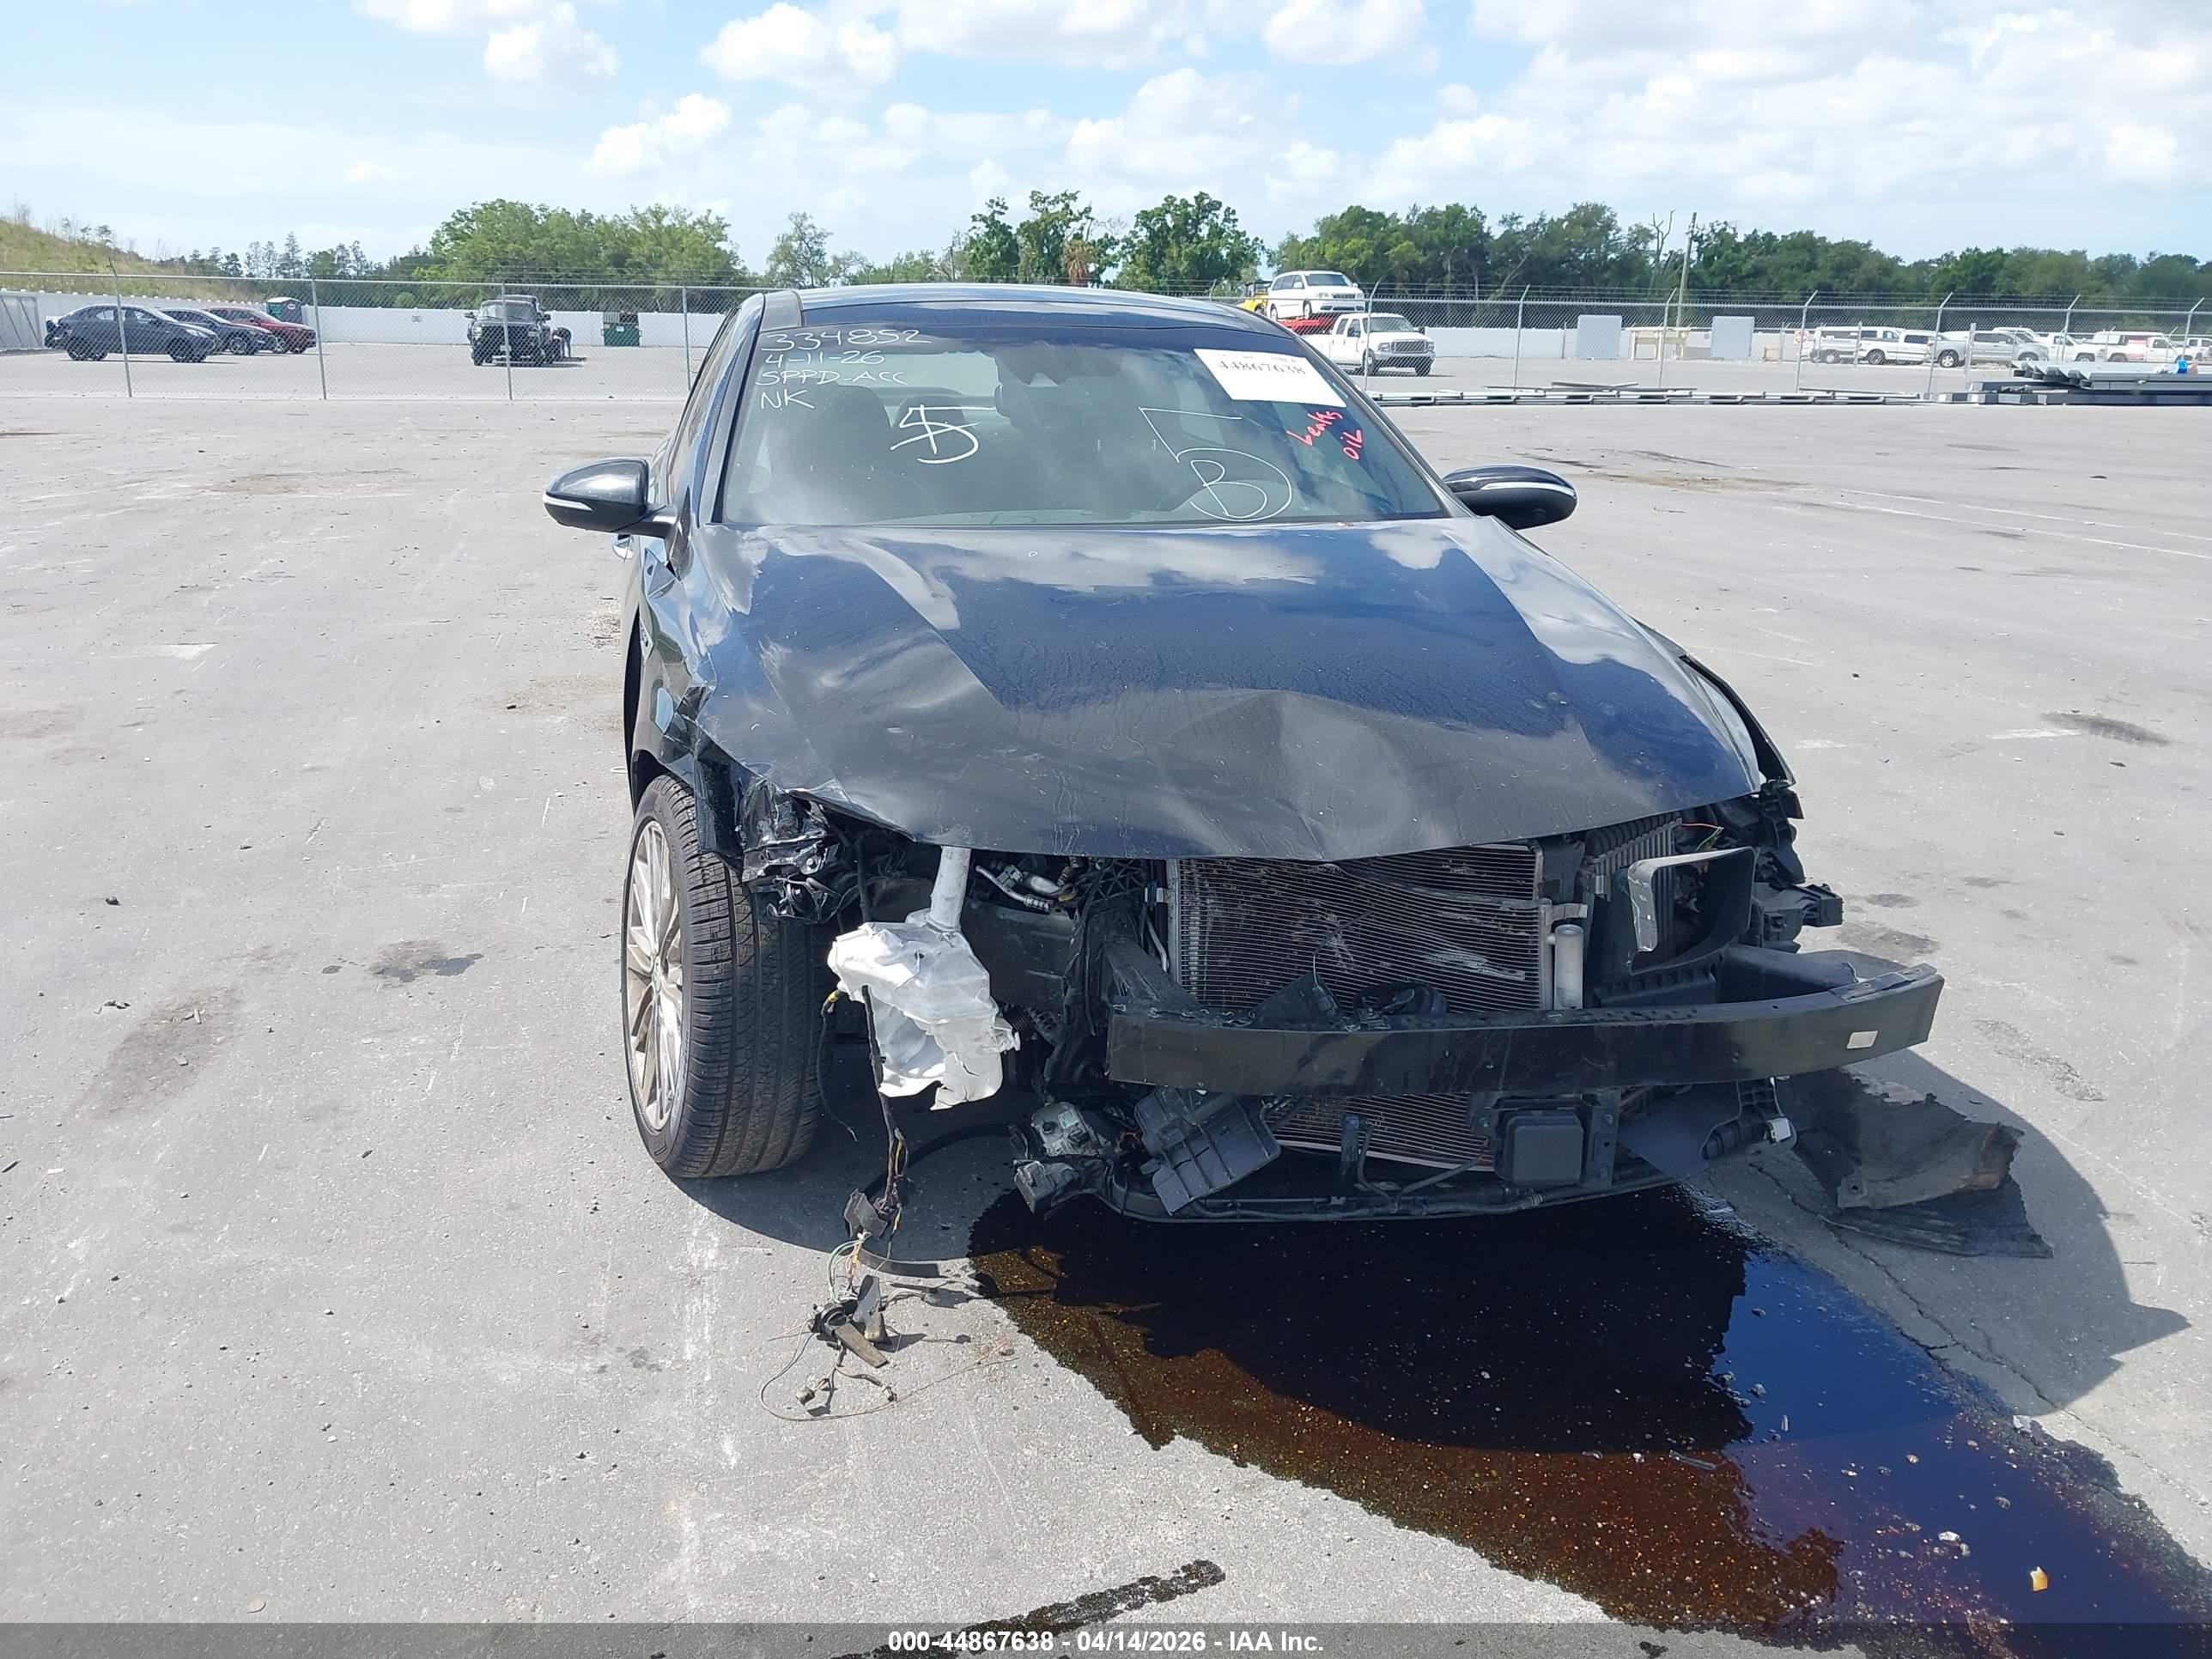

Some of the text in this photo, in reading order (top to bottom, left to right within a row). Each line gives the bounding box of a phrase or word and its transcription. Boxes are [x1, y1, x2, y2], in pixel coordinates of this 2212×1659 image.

[761, 329, 933, 351] 334852
[764, 350, 885, 369] 4-11-26
[761, 388, 816, 410] NK
